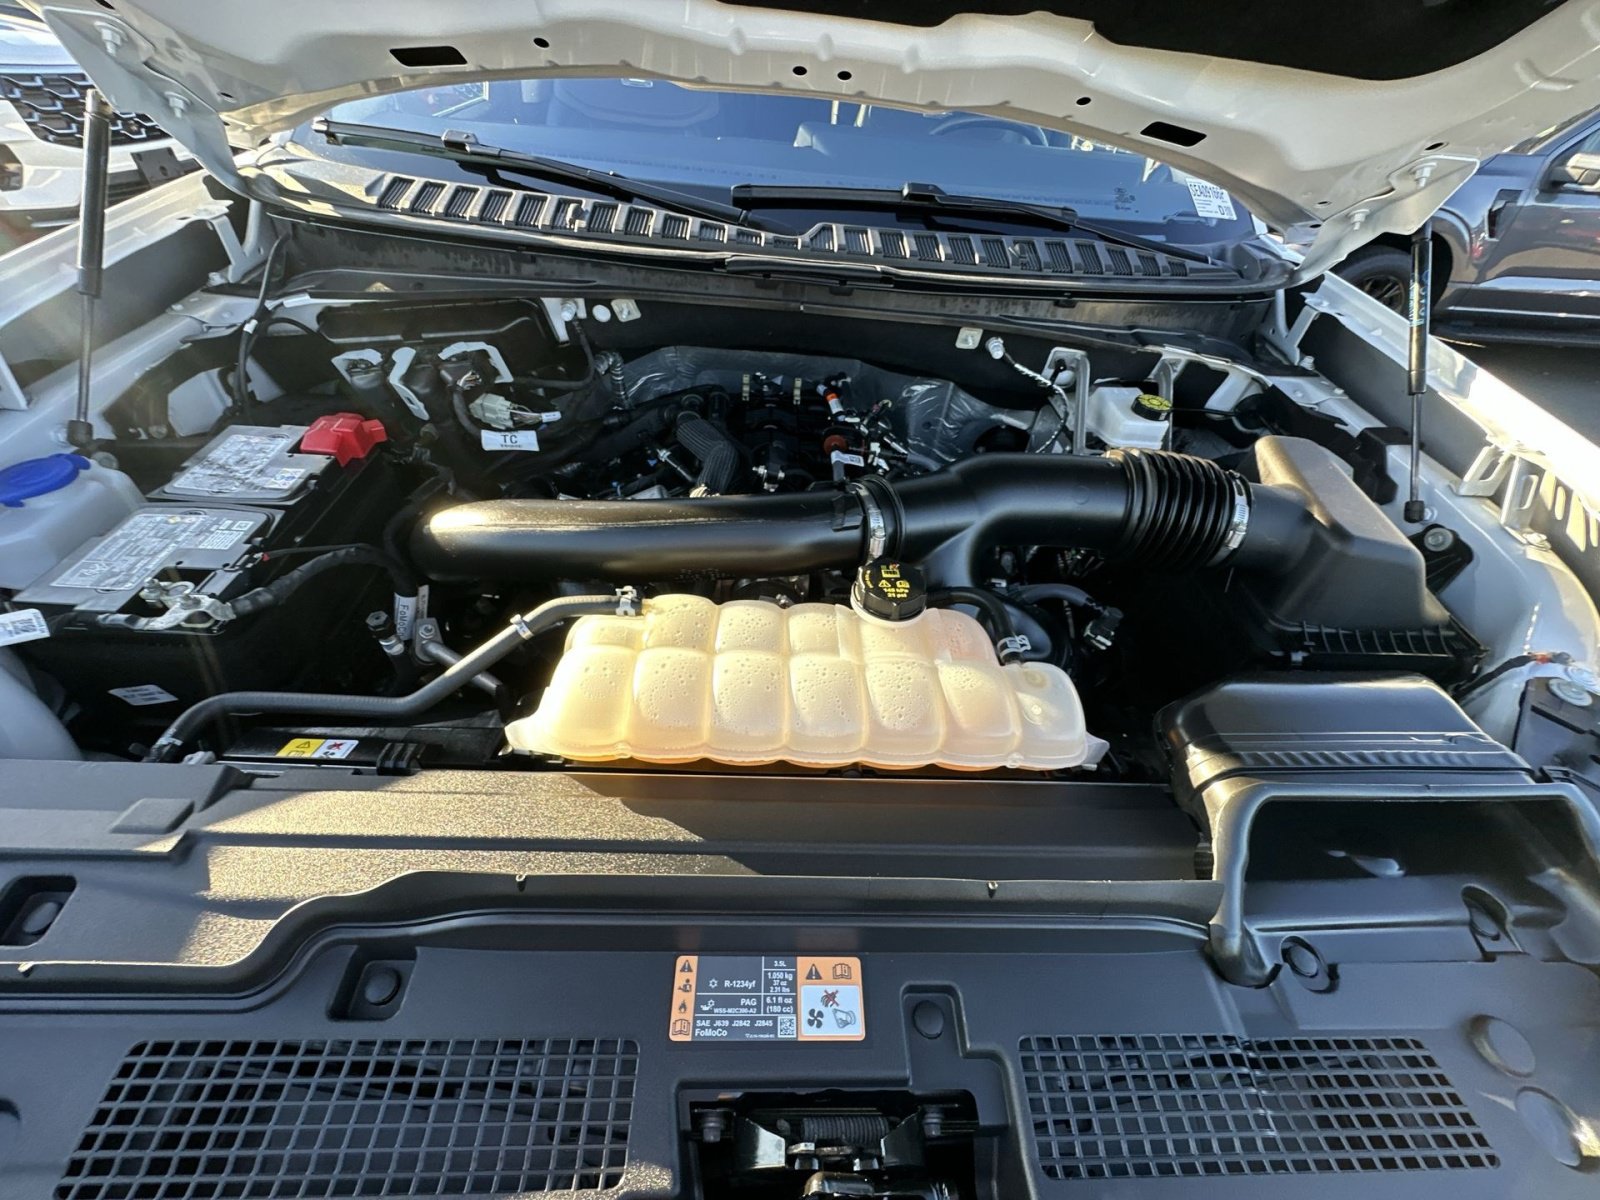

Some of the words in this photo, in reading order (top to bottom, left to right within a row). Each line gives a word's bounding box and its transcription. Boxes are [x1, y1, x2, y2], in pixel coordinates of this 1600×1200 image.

[501, 434, 518, 445] TC
[784, 972, 793, 981] kg
[725, 980, 756, 989] R-1234yf
[740, 998, 757, 1006] PAG
[695, 1028, 728, 1037] FoMoCo
